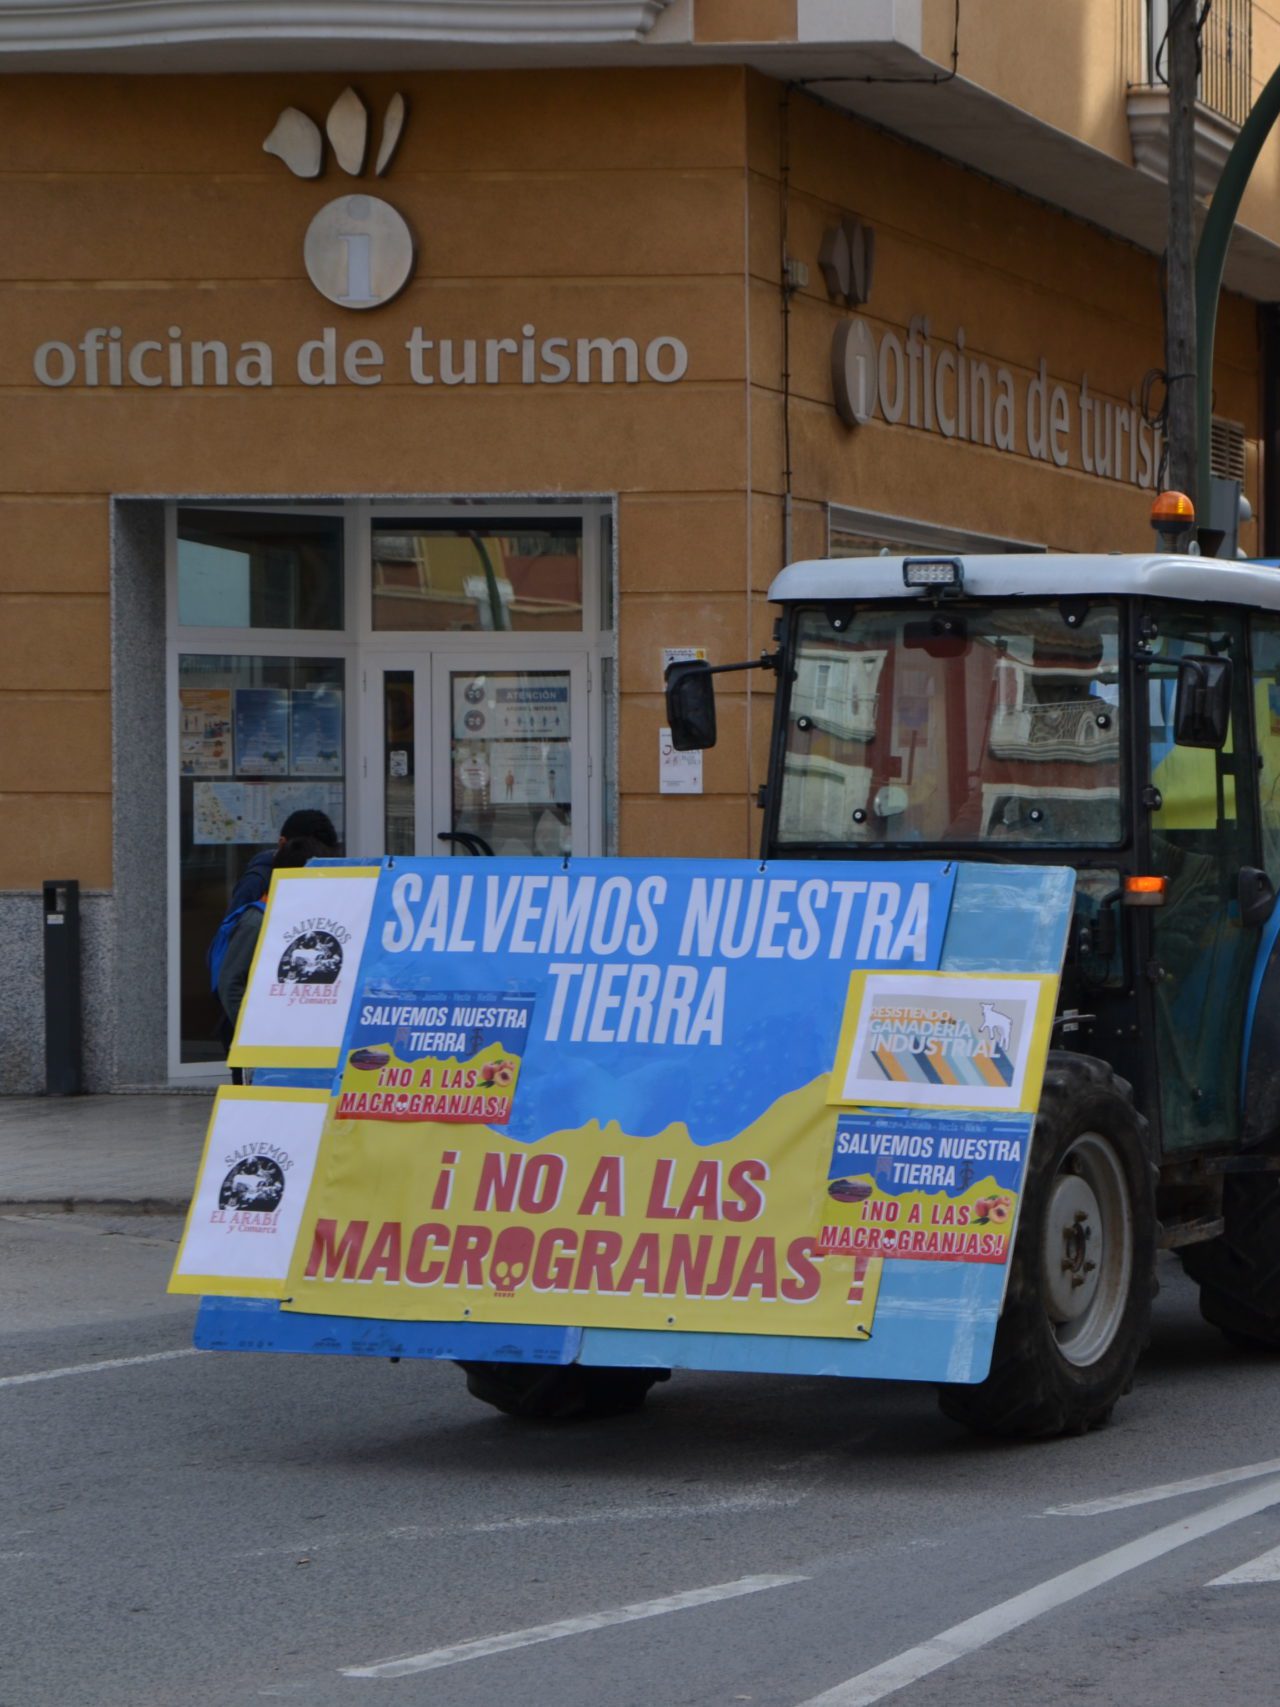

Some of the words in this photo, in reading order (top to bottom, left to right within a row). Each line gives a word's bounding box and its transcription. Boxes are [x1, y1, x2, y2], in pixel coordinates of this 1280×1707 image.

[33, 326, 273, 388] oficina
[297, 327, 386, 386] de
[405, 323, 689, 386] turismo
[878, 313, 1015, 452] oficina
[1027, 355, 1070, 467] de
[381, 872, 668, 957] SALVEMOS
[677, 877, 931, 962] NUESTRA
[282, 916, 352, 945] SALVEMOS
[269, 983, 287, 997] EL
[359, 1005, 449, 1027] SALVEMOS
[451, 1007, 528, 1028] NUESTRA
[544, 962, 728, 1047] TIERRA
[871, 1006, 952, 1021] RESISTIENDO
[870, 1018, 973, 1038] GANADERÍA
[410, 1031, 467, 1053] TIERRA
[870, 1033, 1001, 1058] INDUSTRIAL
[378, 1068, 414, 1088] ¡NO
[419, 1069, 433, 1088] A
[440, 1069, 478, 1089] LAS
[338, 1091, 509, 1117] MACROGRANJAS!
[224, 1142, 294, 1171] SALVEMOS
[836, 1132, 935, 1158] SALVEMOS
[937, 1138, 1021, 1162] NUESTRA
[473, 1151, 568, 1215] NO
[579, 1155, 625, 1217] A
[644, 1158, 771, 1223] LAS
[893, 1162, 956, 1186] TIERRA
[209, 1210, 227, 1224] EL
[860, 1200, 900, 1223] ¡NO
[907, 1202, 922, 1225] A
[930, 1204, 971, 1226] LAS
[819, 1225, 1006, 1256] MACROGRANJAS!
